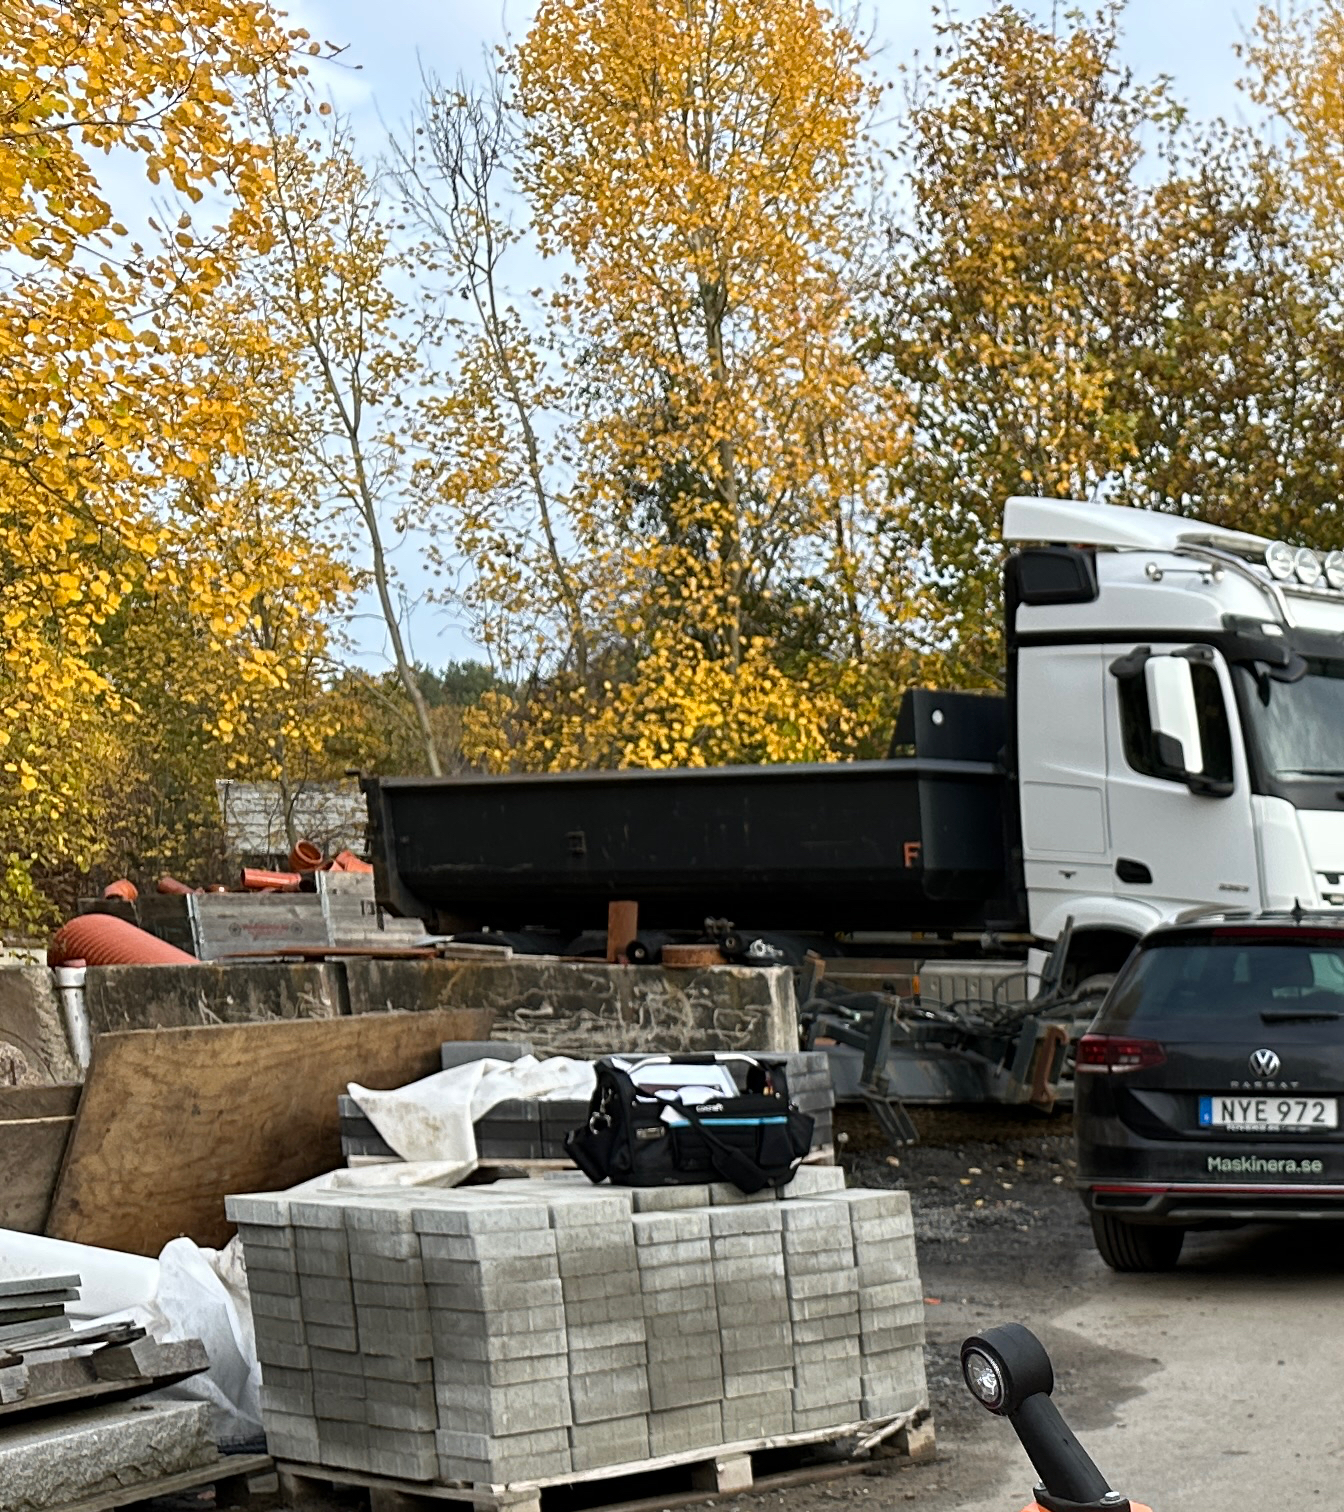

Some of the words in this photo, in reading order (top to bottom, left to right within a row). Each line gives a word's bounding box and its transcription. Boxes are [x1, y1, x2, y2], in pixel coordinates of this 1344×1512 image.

[1221, 1100, 1268, 1122] NYE
[1277, 1100, 1326, 1123] 972
[1207, 1155, 1324, 1174] Maskinera.se
